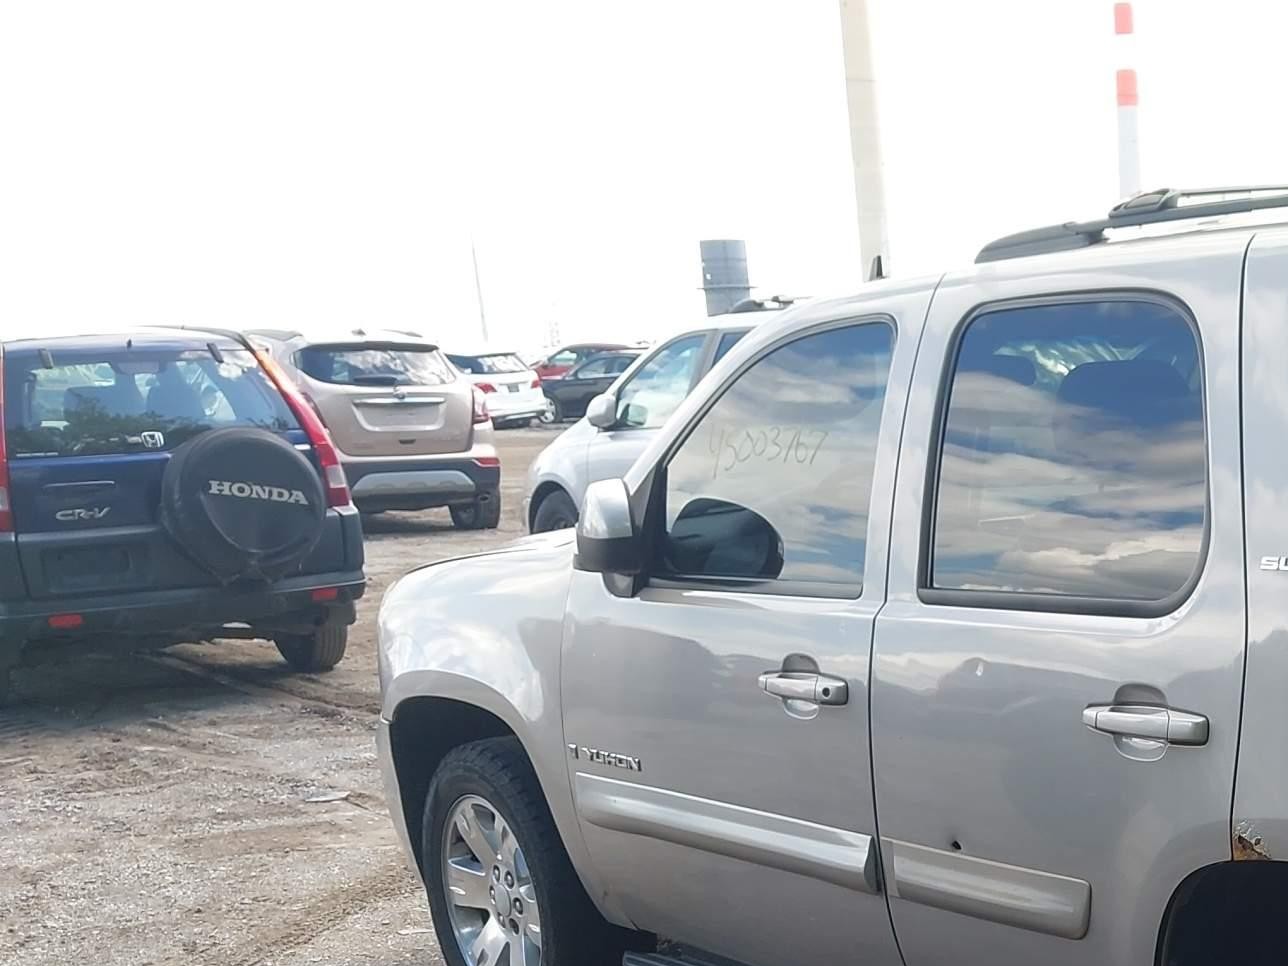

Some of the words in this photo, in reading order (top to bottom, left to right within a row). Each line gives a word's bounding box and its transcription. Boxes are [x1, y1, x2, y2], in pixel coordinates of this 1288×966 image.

[208, 480, 309, 505] HONDA
[56, 507, 111, 520] CR-V
[582, 748, 642, 771] YUKON
